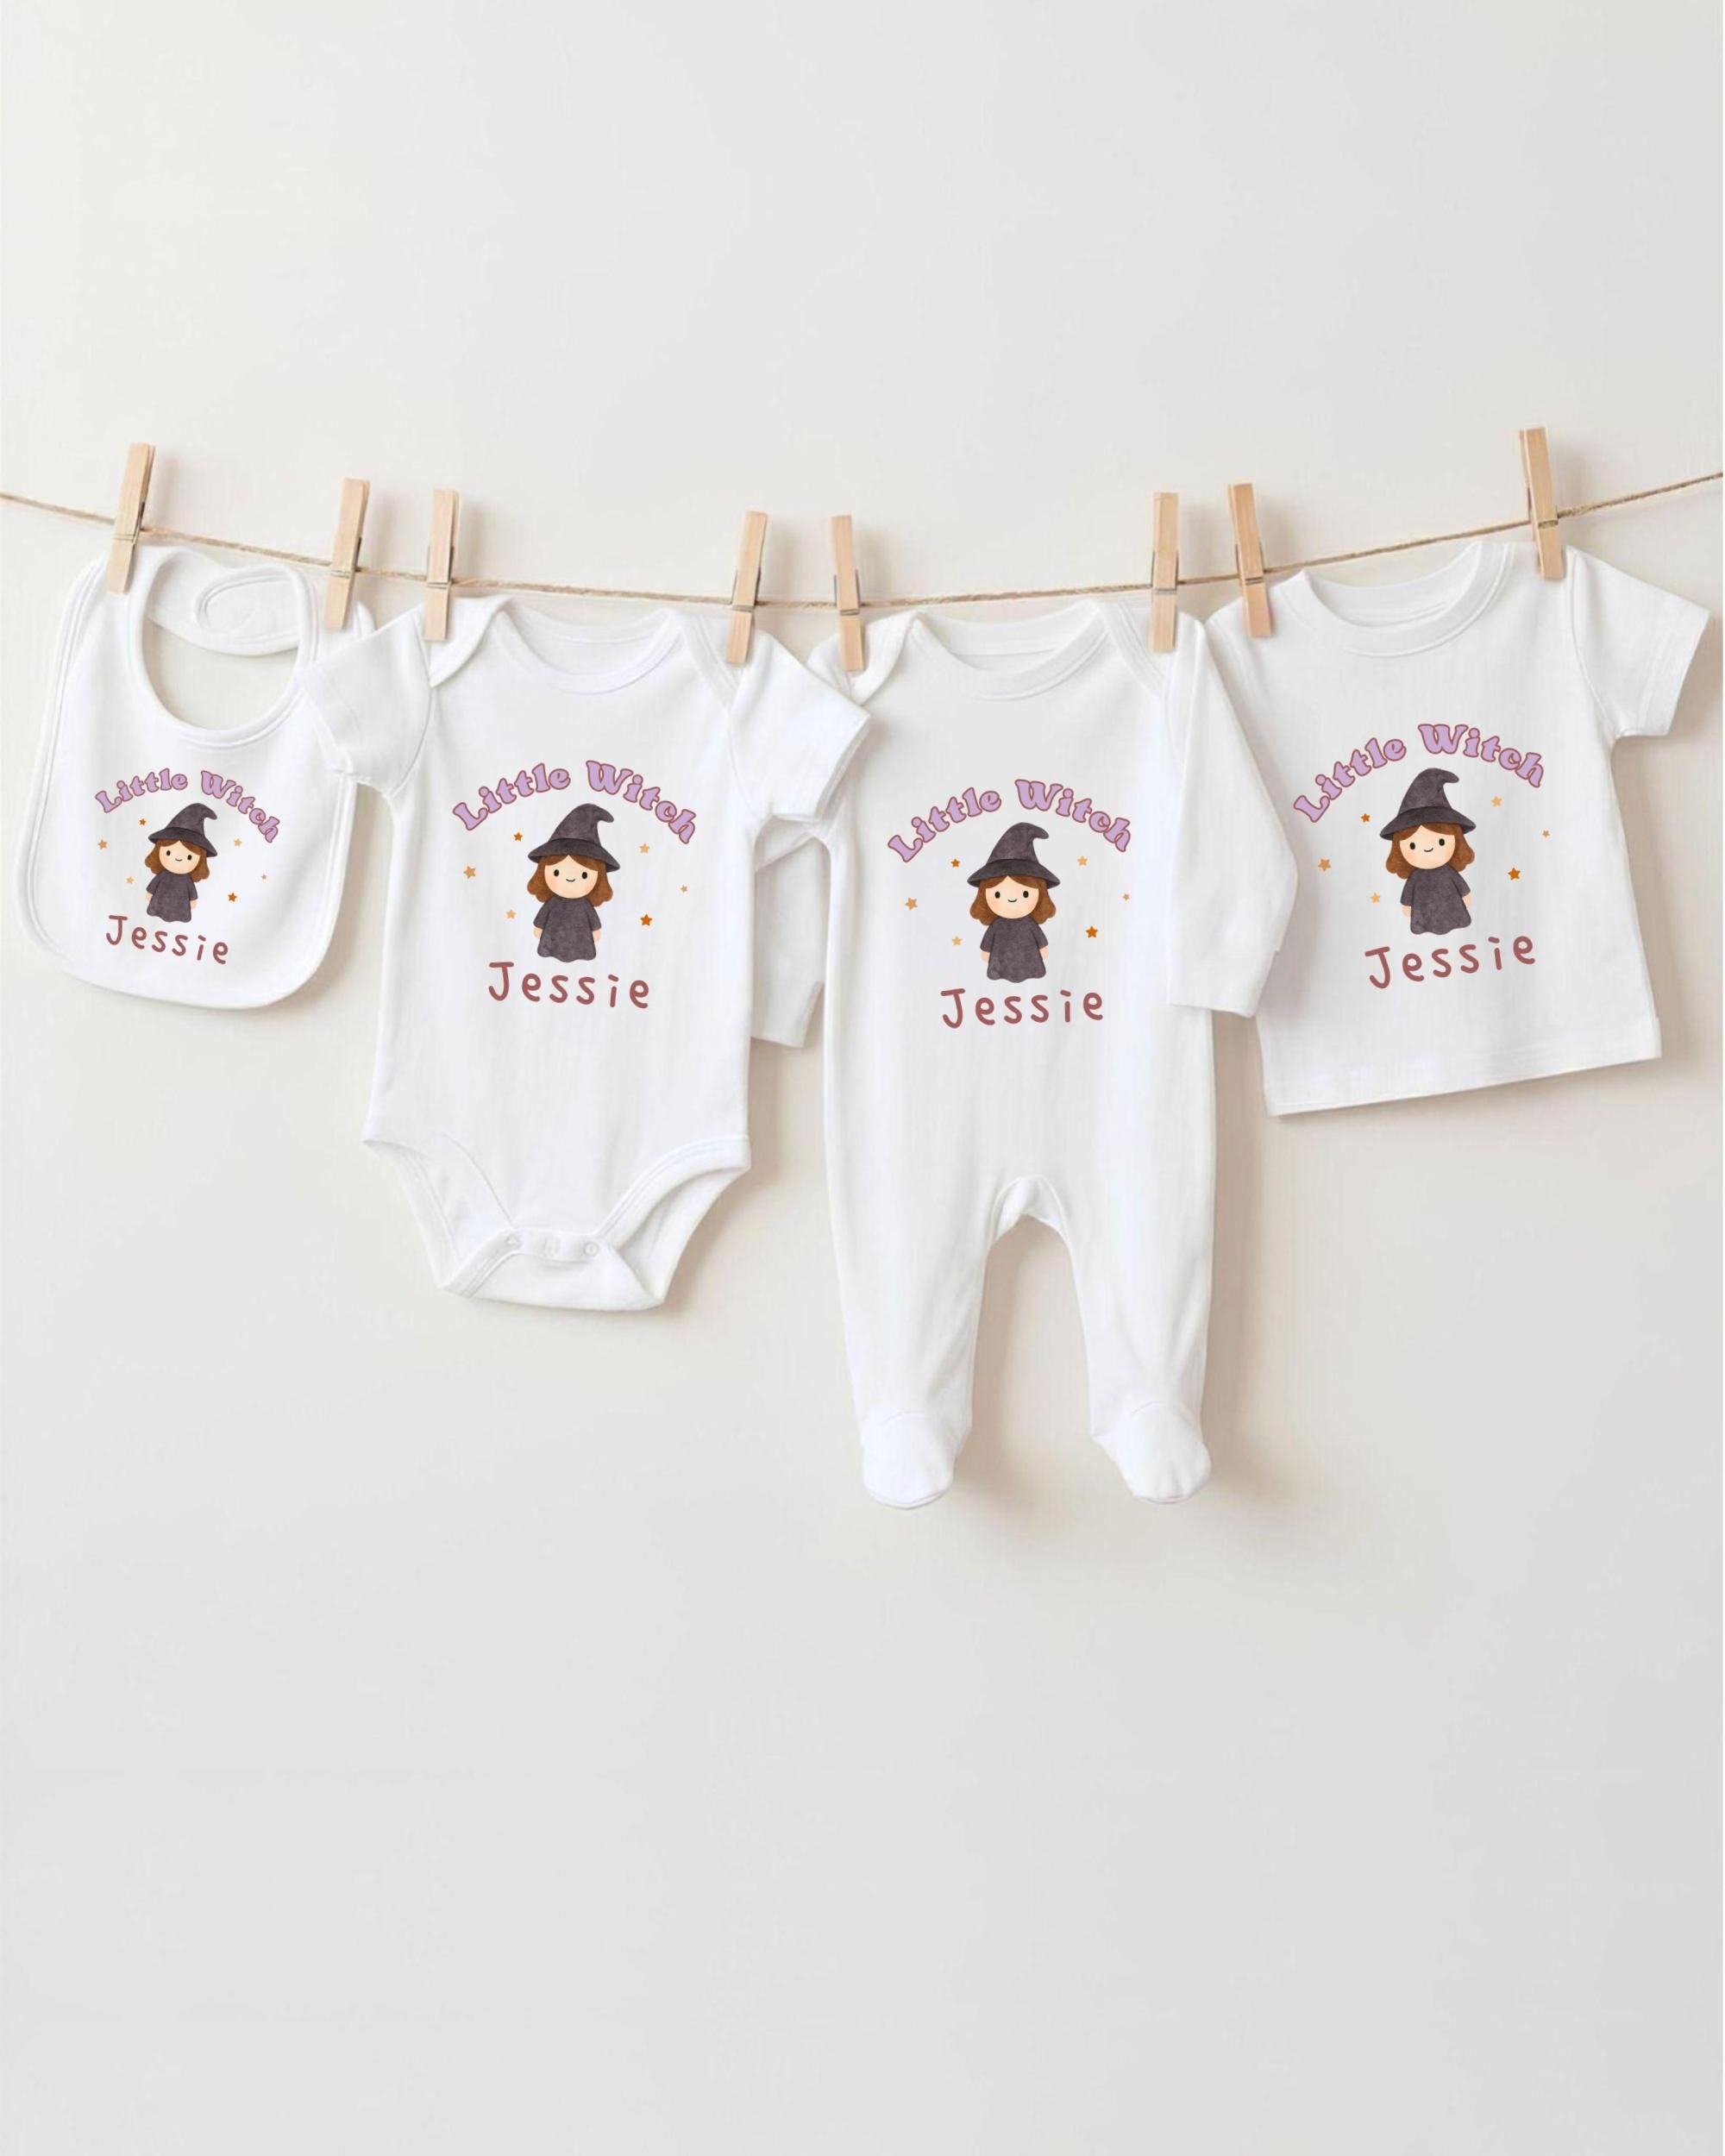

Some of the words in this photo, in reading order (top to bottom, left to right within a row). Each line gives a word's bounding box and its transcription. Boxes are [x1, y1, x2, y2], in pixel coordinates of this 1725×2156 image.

[95, 768, 187, 813] Little
[202, 770, 279, 843] Witch
[453, 763, 571, 831] Little
[586, 761, 697, 843] Witch
[1293, 737, 1406, 822] Little
[1418, 724, 1545, 788] Witch
[888, 787, 1001, 862] Little
[1014, 780, 1131, 852] Witch
[105, 914, 229, 965] Jessie
[1364, 934, 1536, 990] Jessie
[487, 961, 650, 1010] Jessie
[940, 987, 1103, 1030] Jessie
